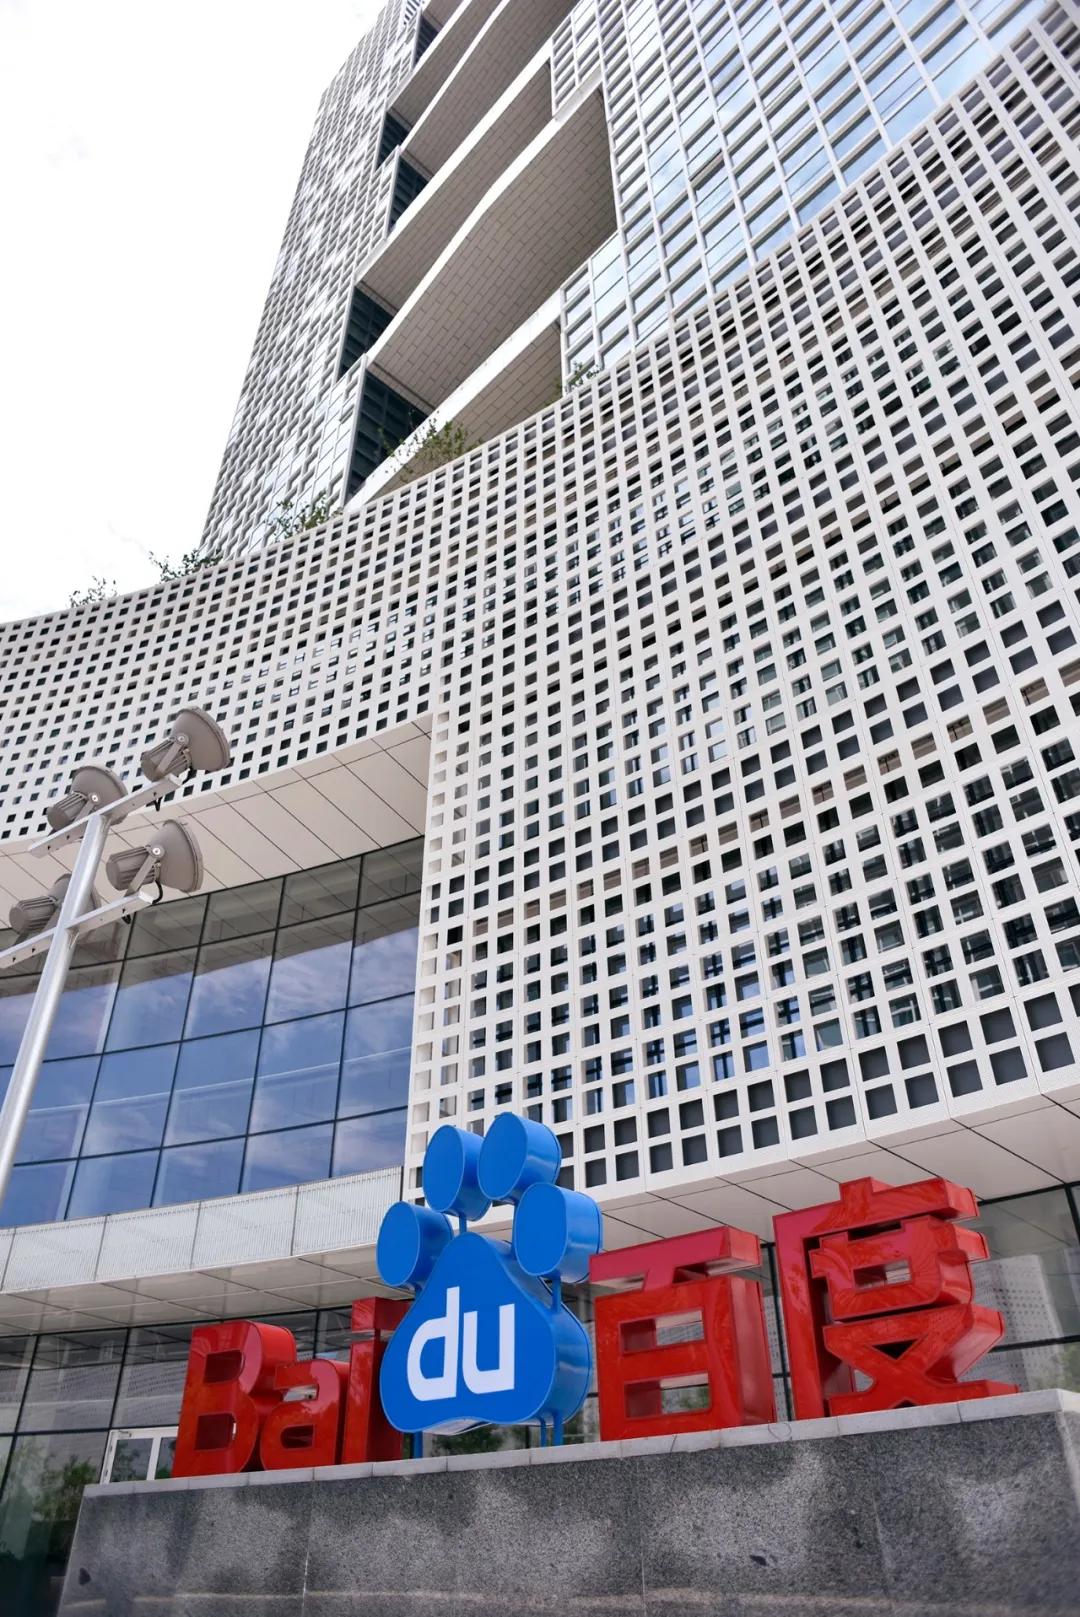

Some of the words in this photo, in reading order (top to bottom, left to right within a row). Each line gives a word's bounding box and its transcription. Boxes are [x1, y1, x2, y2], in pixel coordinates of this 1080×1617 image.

[171, 1297, 404, 1478] Bai
[406, 1286, 515, 1402] du
[589, 1176, 1018, 1441] 百度
